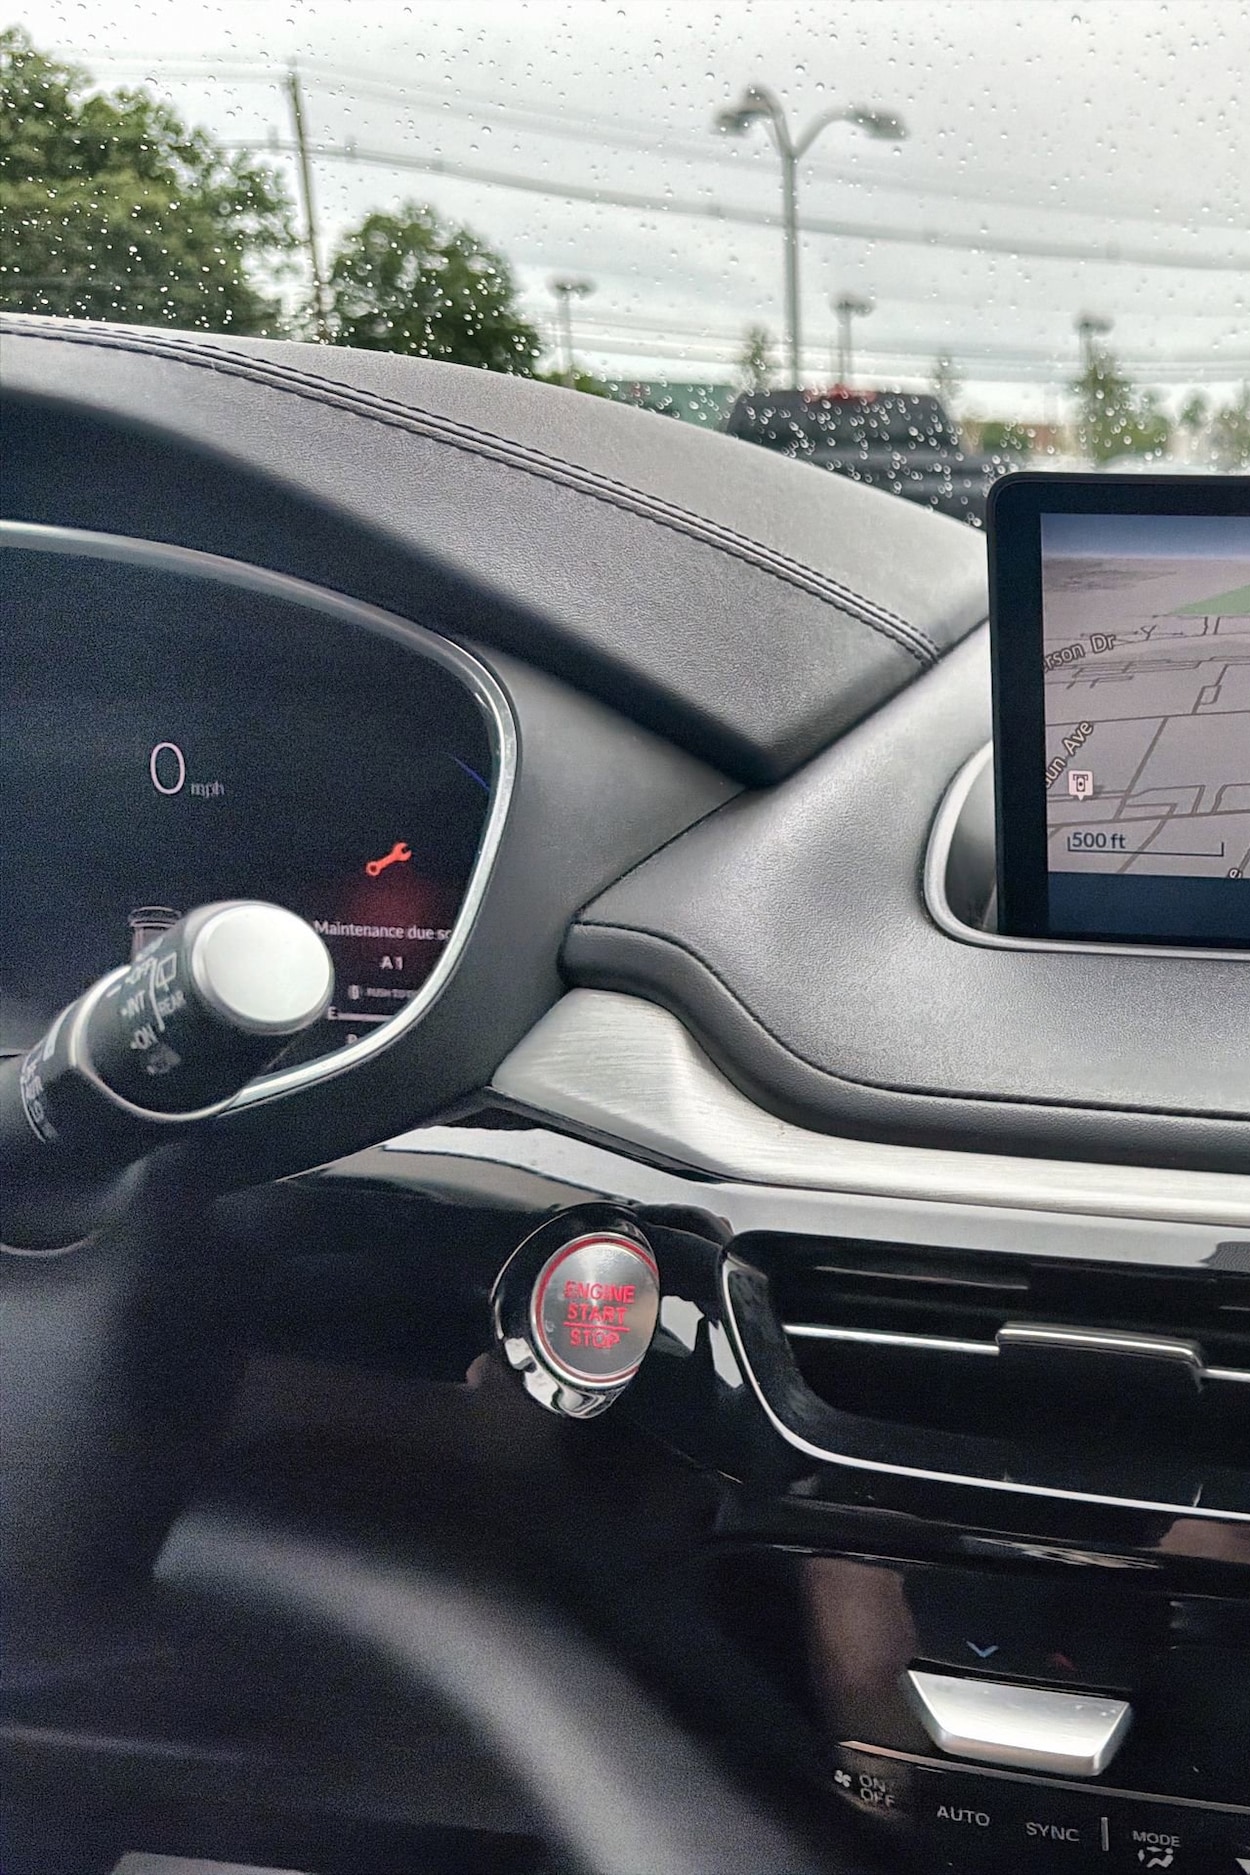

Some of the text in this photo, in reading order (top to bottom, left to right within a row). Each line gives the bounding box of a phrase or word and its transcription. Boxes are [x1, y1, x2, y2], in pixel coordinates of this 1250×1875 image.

[1091, 634, 1116, 653] Dr
[1062, 720, 1094, 756] Ave
[150, 742, 185, 795] 0
[190, 781, 225, 799] mph
[1072, 832, 1126, 849] 500 ft
[312, 920, 405, 939] Maintenance
[407, 925, 436, 940] due
[564, 1280, 636, 1304] ENGINE
[567, 1304, 628, 1324] START
[569, 1328, 621, 1349] STOP
[859, 1774, 886, 1793] ON
[860, 1787, 896, 1808] OFF
[936, 1805, 1181, 1848] AUTO SYNC MODE
